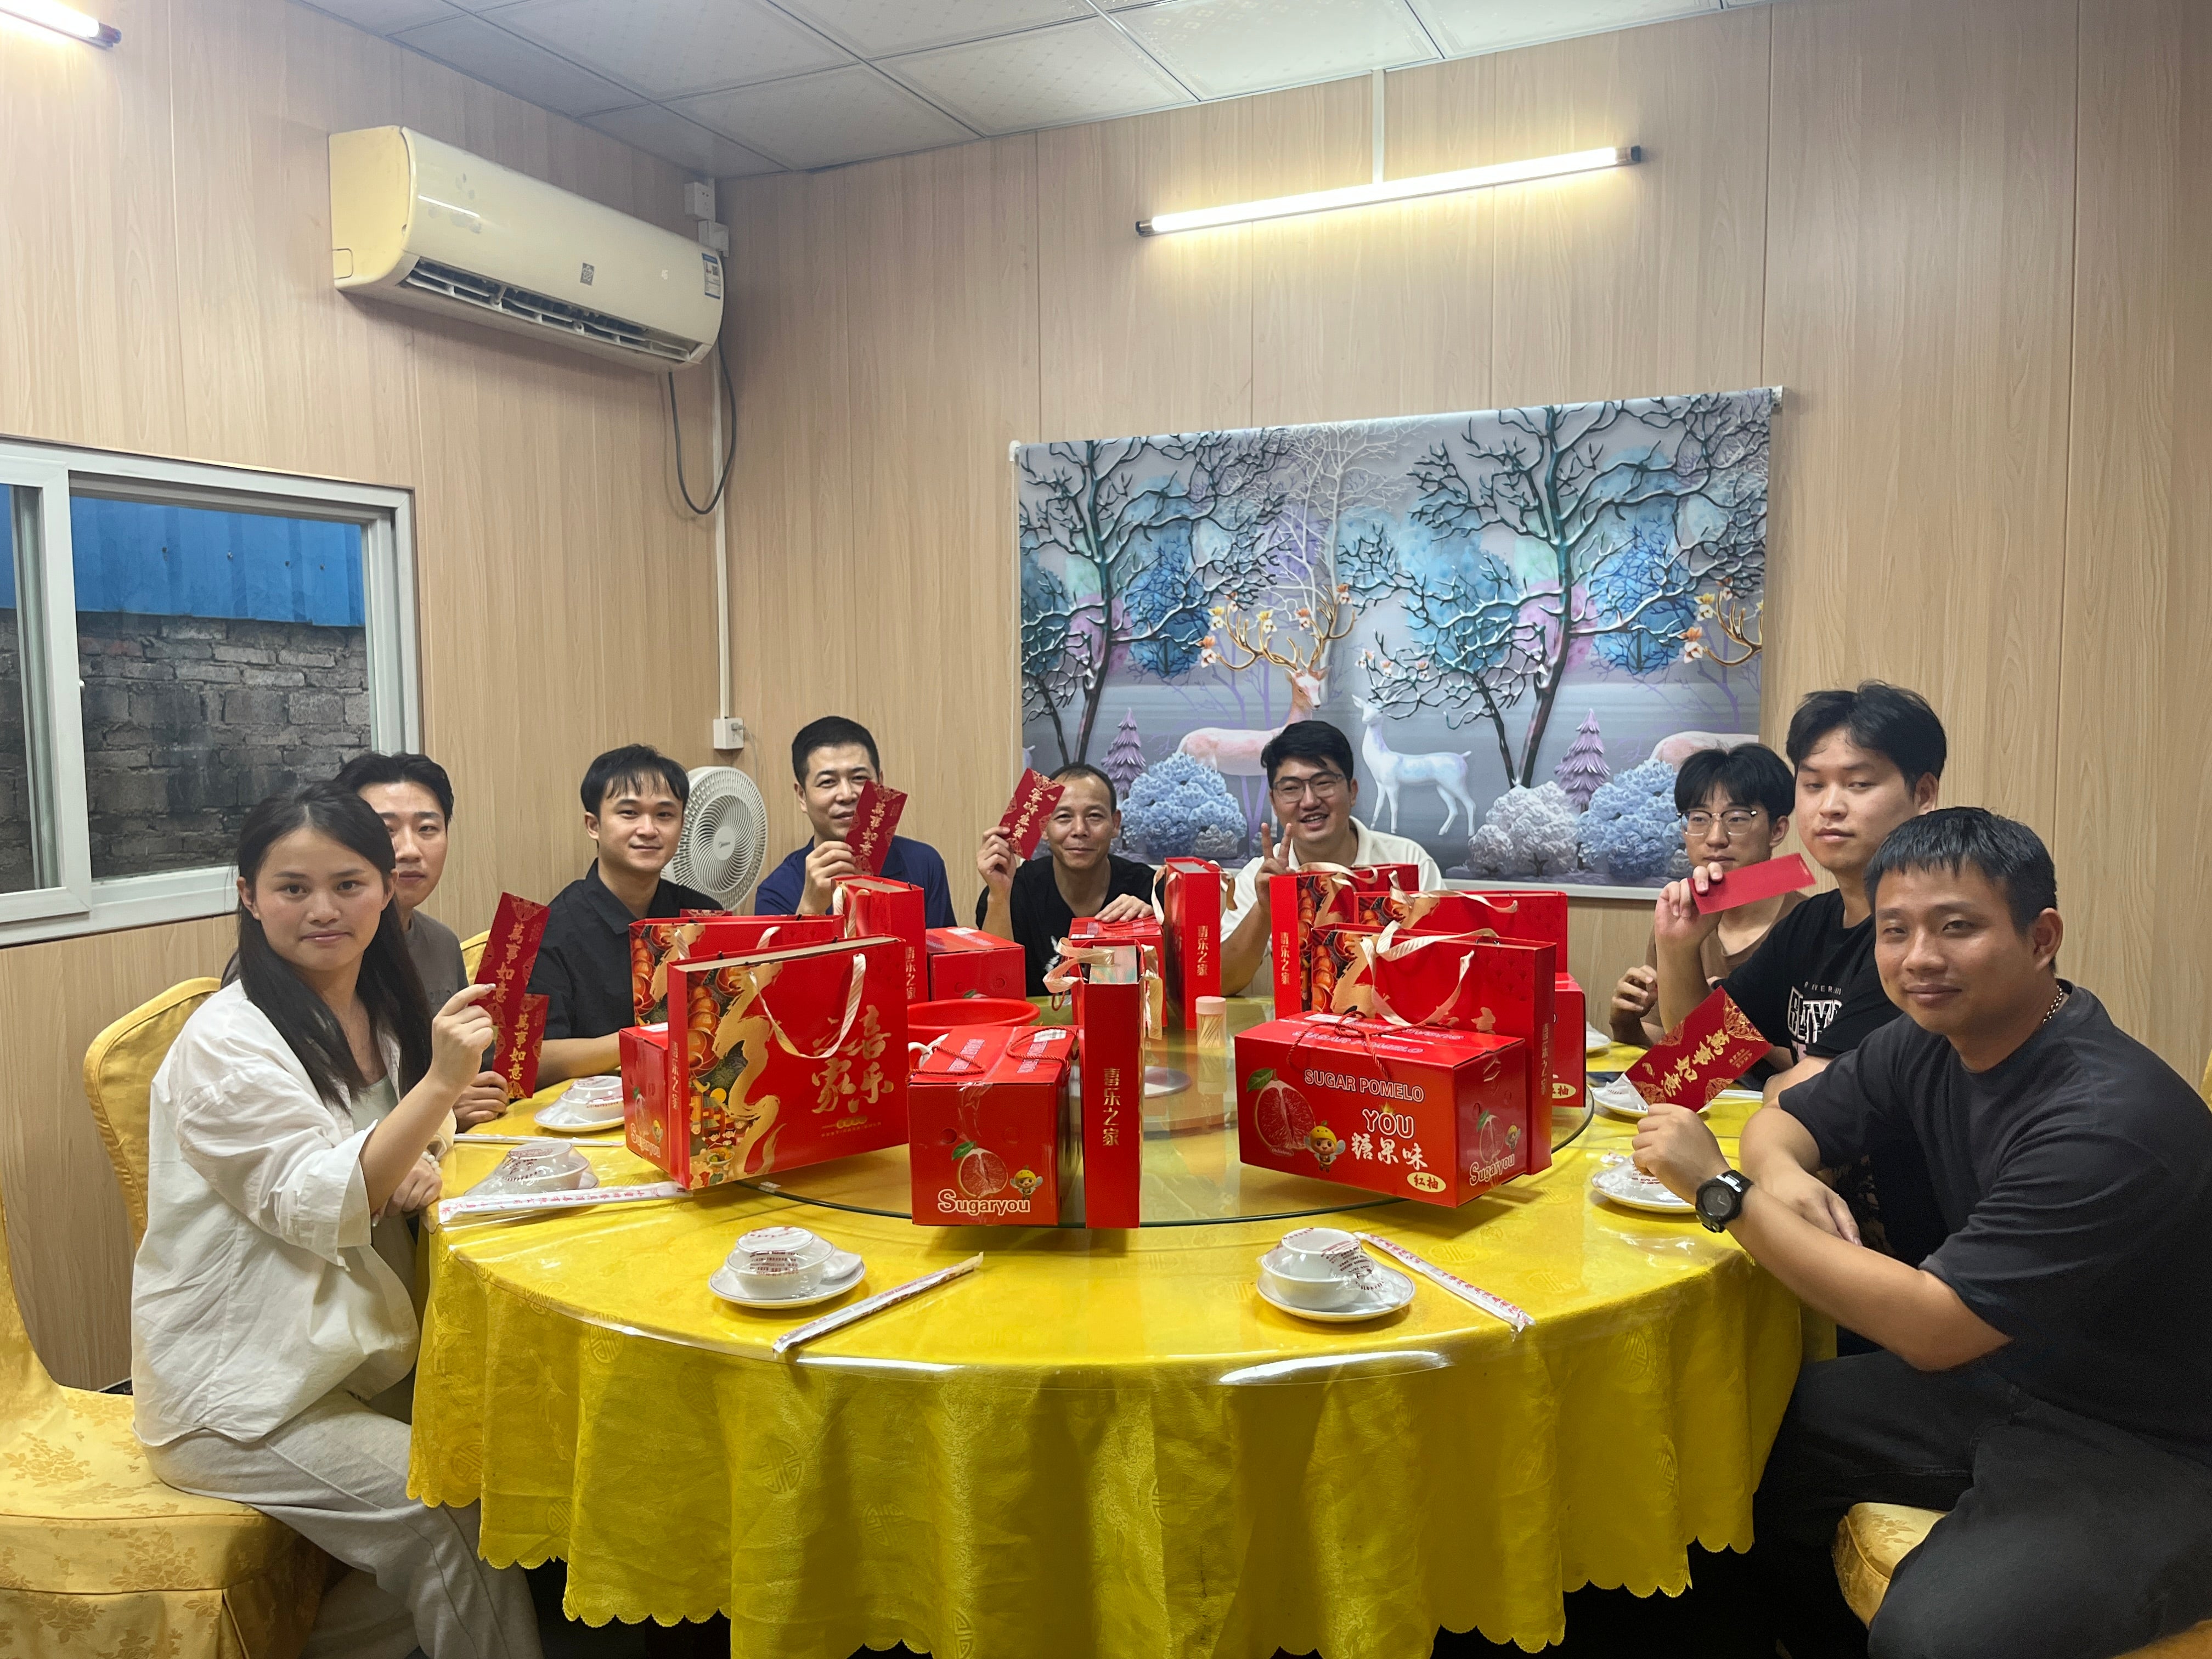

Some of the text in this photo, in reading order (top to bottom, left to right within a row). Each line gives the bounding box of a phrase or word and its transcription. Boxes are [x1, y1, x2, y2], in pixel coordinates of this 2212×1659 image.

[493, 922, 524, 1003] 萬事如意
[1197, 926, 1209, 976] 喜乐之家
[1280, 932, 1290, 985] 喜乐之家
[507, 1013, 530, 1081] 萬事如意
[1304, 1069, 1425, 1103] SUGAR POMELO
[1103, 1068, 1120, 1146] 喜乐之家
[1362, 1108, 1415, 1139] YOU
[630, 1122, 661, 1158] Sugaryou
[1351, 1132, 1428, 1171] 糖果味
[1413, 1174, 1439, 1190] 红柚
[1469, 1153, 1515, 1186] Sugaryou
[938, 1188, 1031, 1216] Sugaryou
